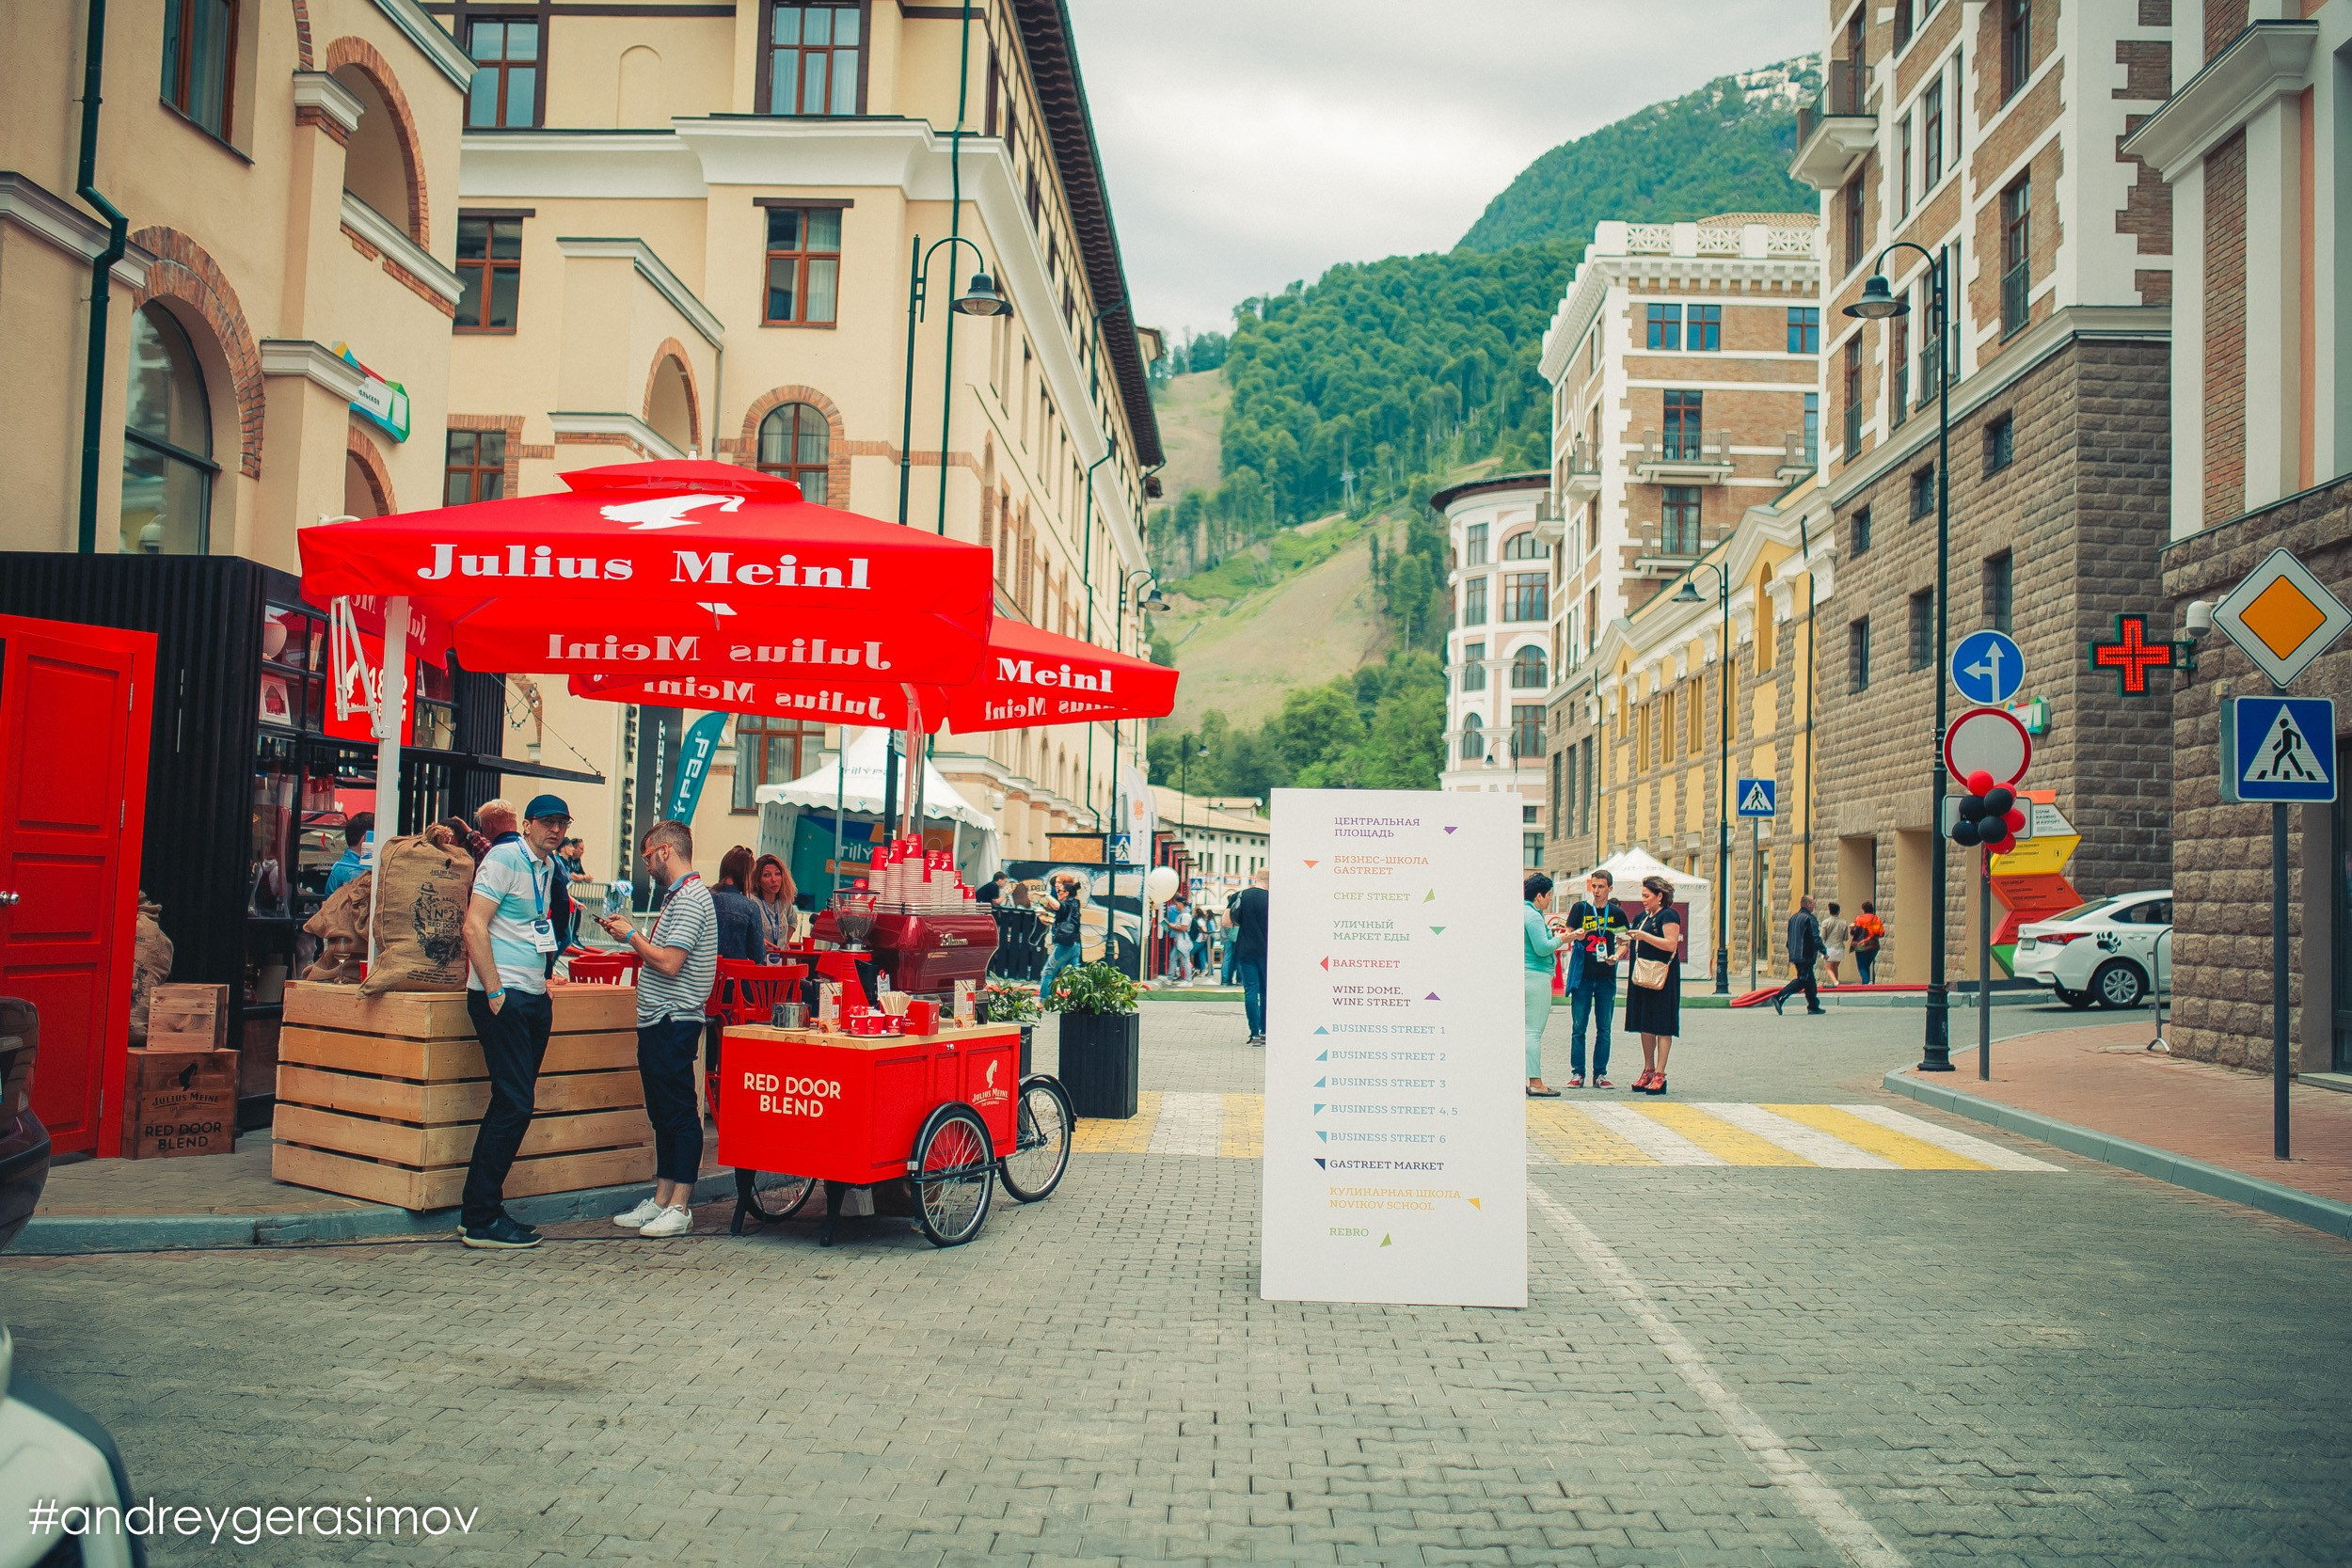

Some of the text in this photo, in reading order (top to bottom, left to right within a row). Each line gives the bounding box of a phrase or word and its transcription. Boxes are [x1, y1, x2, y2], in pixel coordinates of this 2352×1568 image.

[418, 544, 871, 590] Julius Meinl
[996, 657, 1114, 693] Meinl
[1334, 816, 1421, 827] ЦЕНТРАЛЬНАЯ
[1334, 829, 1394, 838] ПЛОЩАДЬ
[1333, 855, 1429, 865] БИЗНЕС-ШКОЛА
[1333, 866, 1393, 876] GASTREET
[1333, 892, 1411, 901] CHEF STREET
[1333, 918, 1394, 930] УЛИЧНЫЙ
[1332, 931, 1410, 942] МАРКЕТ ЕДЫ
[1332, 958, 1401, 969] BARSTREET
[1331, 985, 1404, 996] WINE DOME,
[1331, 997, 1411, 1007] WINE STREET
[1331, 1023, 1446, 1035] BUSINESS STREET 1
[1331, 1050, 1446, 1061] BUSINESS STREET 2
[743, 1071, 841, 1100] RED DOOR
[1331, 1077, 1446, 1088] BUSINESS STREET 3
[152, 1092, 219, 1106] JULIUS MEINL
[972, 1090, 992, 1103] JULIUS
[759, 1094, 824, 1118] BLEND
[1330, 1104, 1388, 1114] BUSINESS
[1390, 1105, 1436, 1115] STREET
[1451, 1106, 1458, 1116] 5
[144, 1121, 222, 1138] RED DOOR
[158, 1135, 209, 1150] BLEND
[1330, 1132, 1446, 1144] BUSINESS STREET 6
[1329, 1159, 1445, 1171] GASTREET MARKET
[1329, 1187, 1461, 1198] КУЛИНАРНАЯ ШКОЛА
[1329, 1199, 1435, 1211] NOVIKOV SCHOOL
[1328, 1227, 1370, 1237] REBRO
